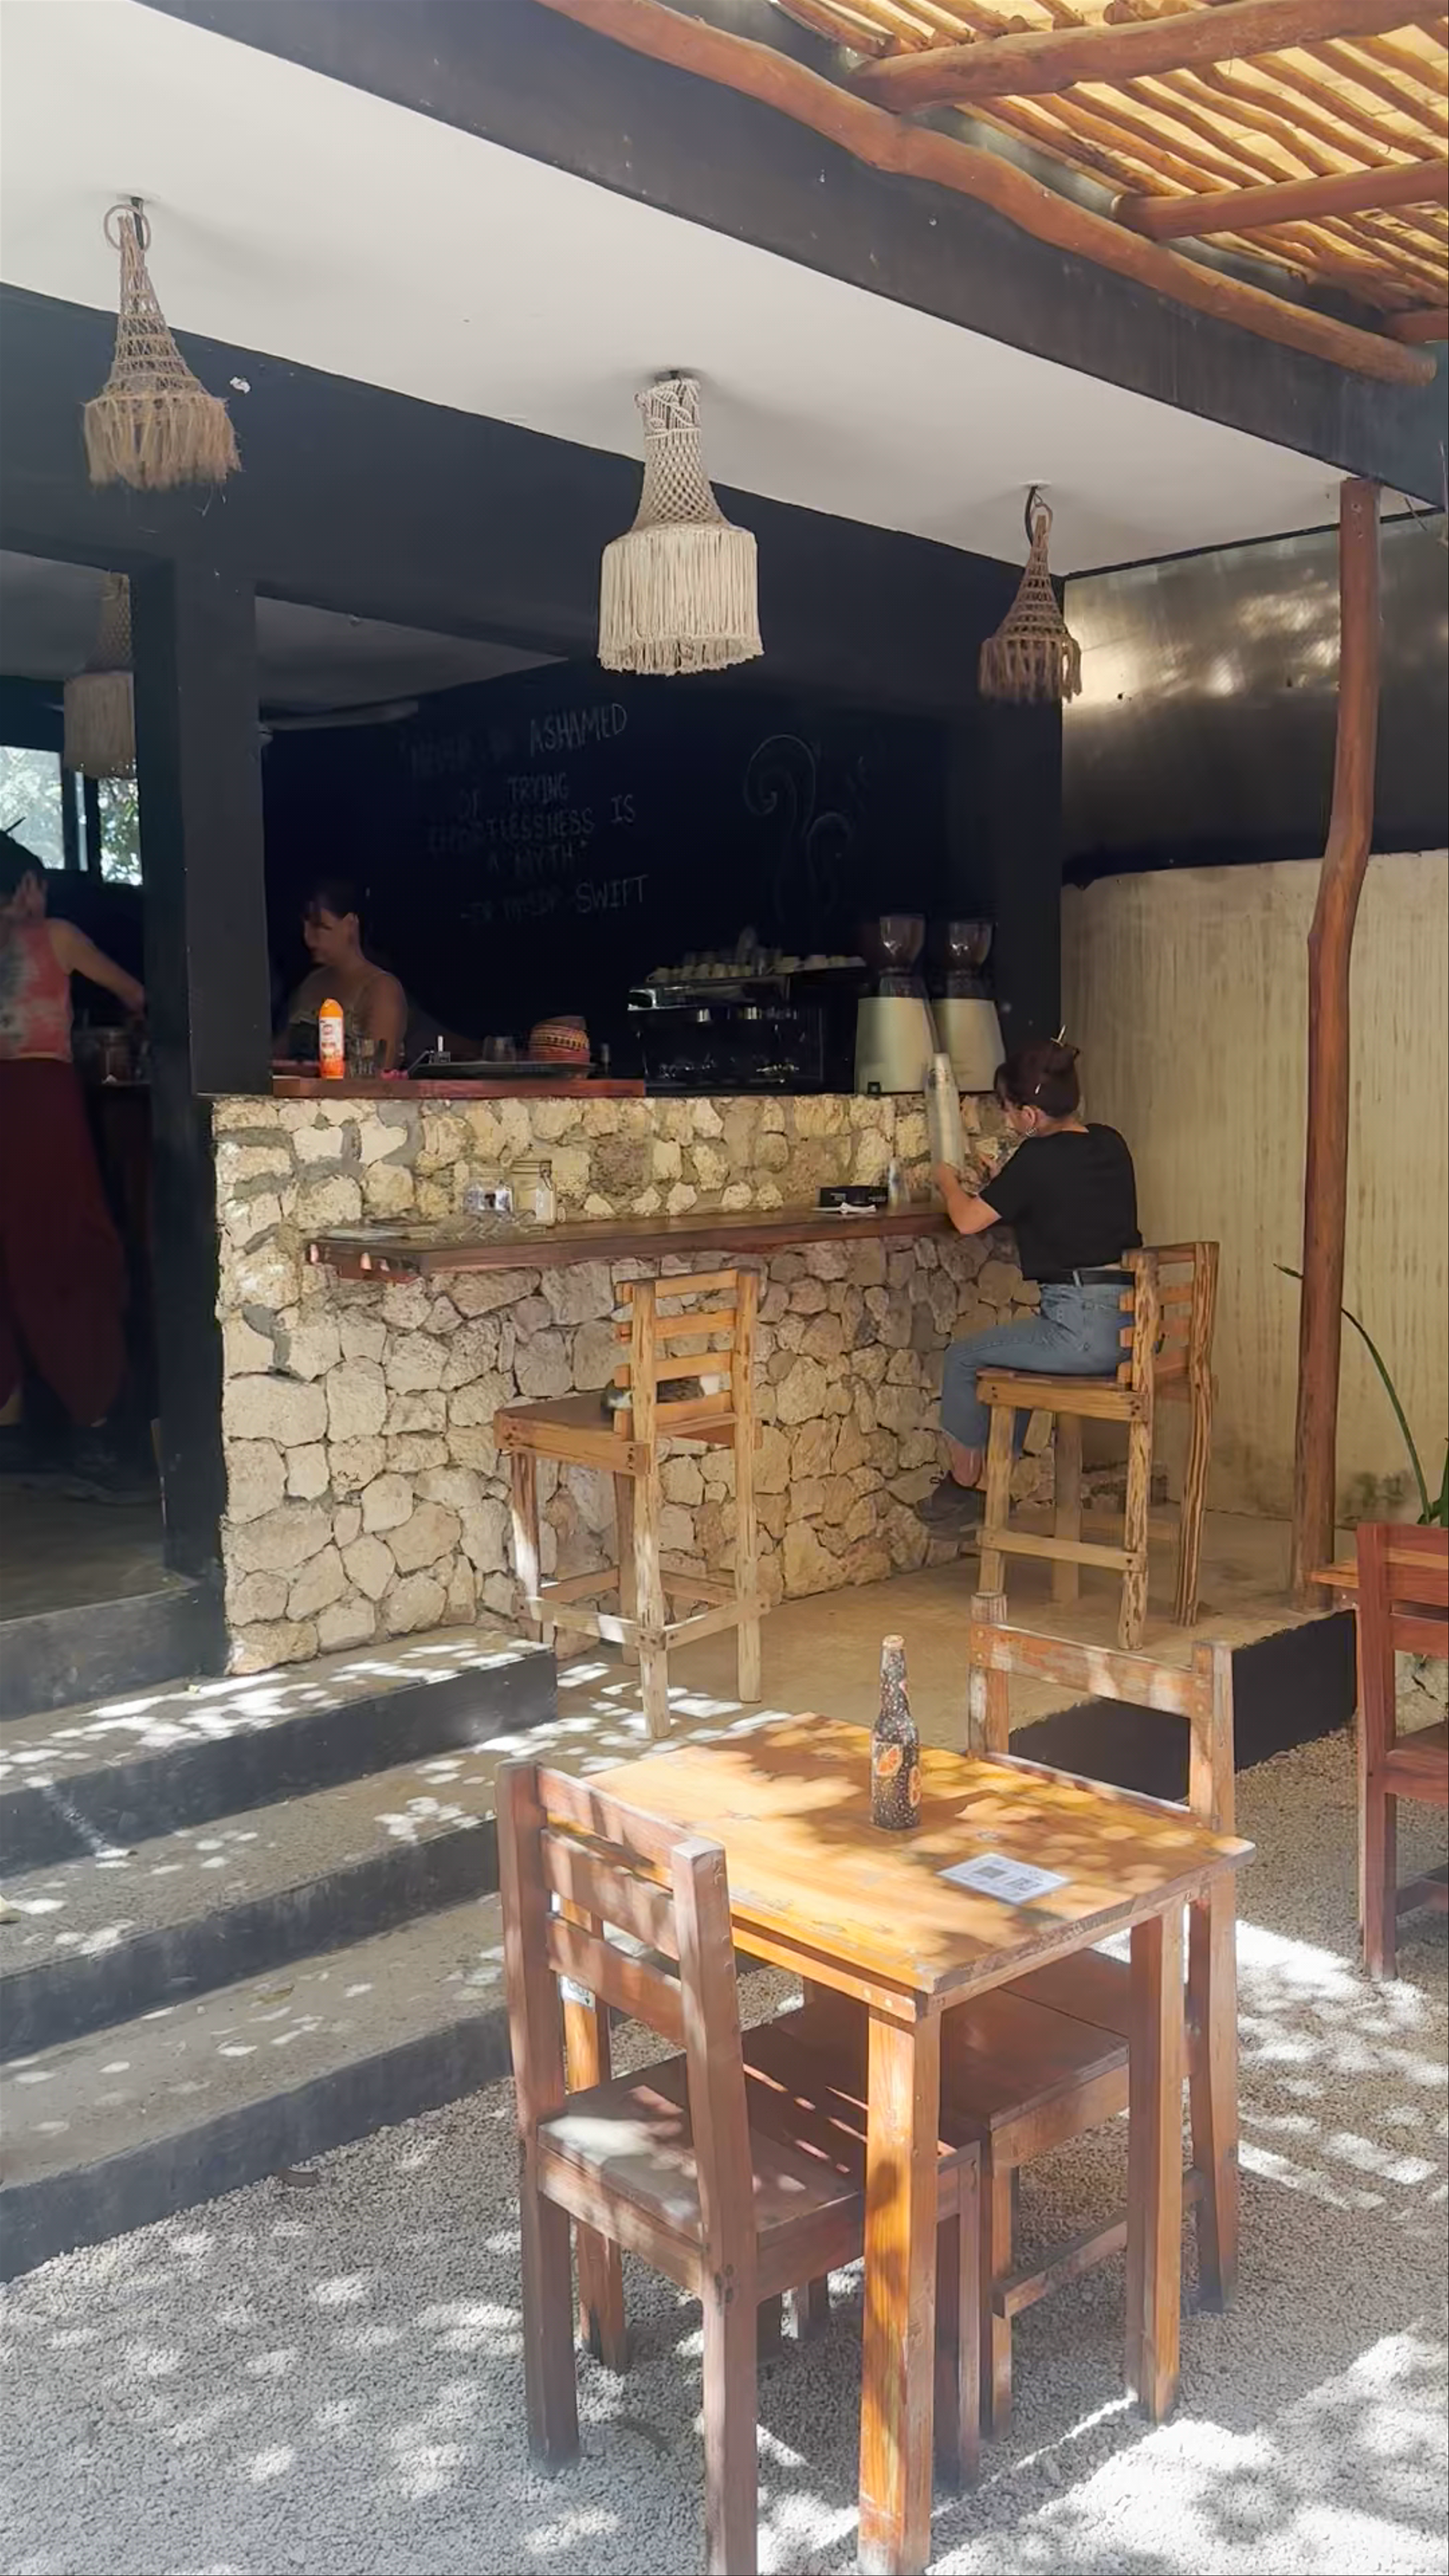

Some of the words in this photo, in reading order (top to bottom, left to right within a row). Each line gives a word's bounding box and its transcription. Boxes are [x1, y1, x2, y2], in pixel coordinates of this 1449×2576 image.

[529, 703, 628, 758] ASHAMED
[507, 772, 569, 805] TRYING
[426, 808, 595, 859] TLESSNESS
[610, 794, 636, 824] IS
[574, 874, 649, 914] SWIFT
